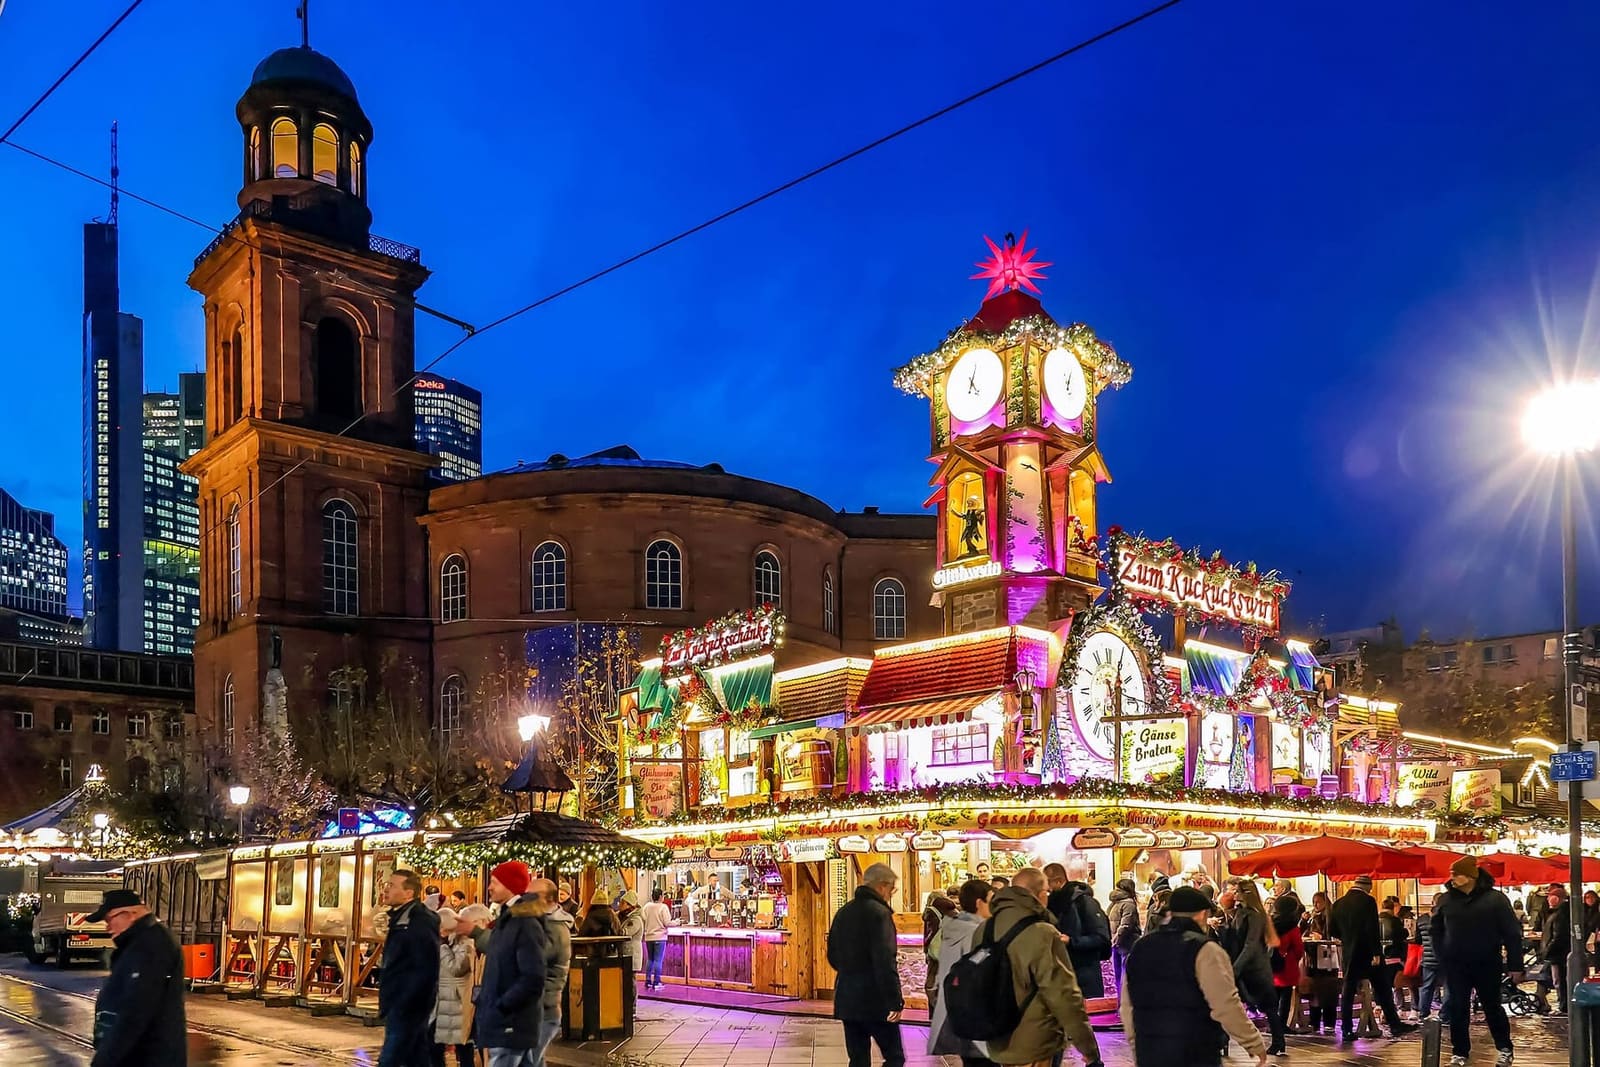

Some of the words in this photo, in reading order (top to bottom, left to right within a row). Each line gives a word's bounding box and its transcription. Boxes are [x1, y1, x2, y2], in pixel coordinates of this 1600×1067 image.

[419, 379, 446, 390] Deka
[1120, 552, 1165, 592] Zum
[1140, 728, 1177, 747] Gänse
[1135, 744, 1172, 762] Braten
[640, 767, 673, 780] Glühwein
[1411, 768, 1439, 780] Wild
[1408, 777, 1450, 790] Bratwurst
[1456, 786, 1491, 805] Glühwein
[877, 814, 921, 831] Steaks
[977, 809, 1080, 829] Gänsebraten
[794, 842, 825, 854] Glühwein
